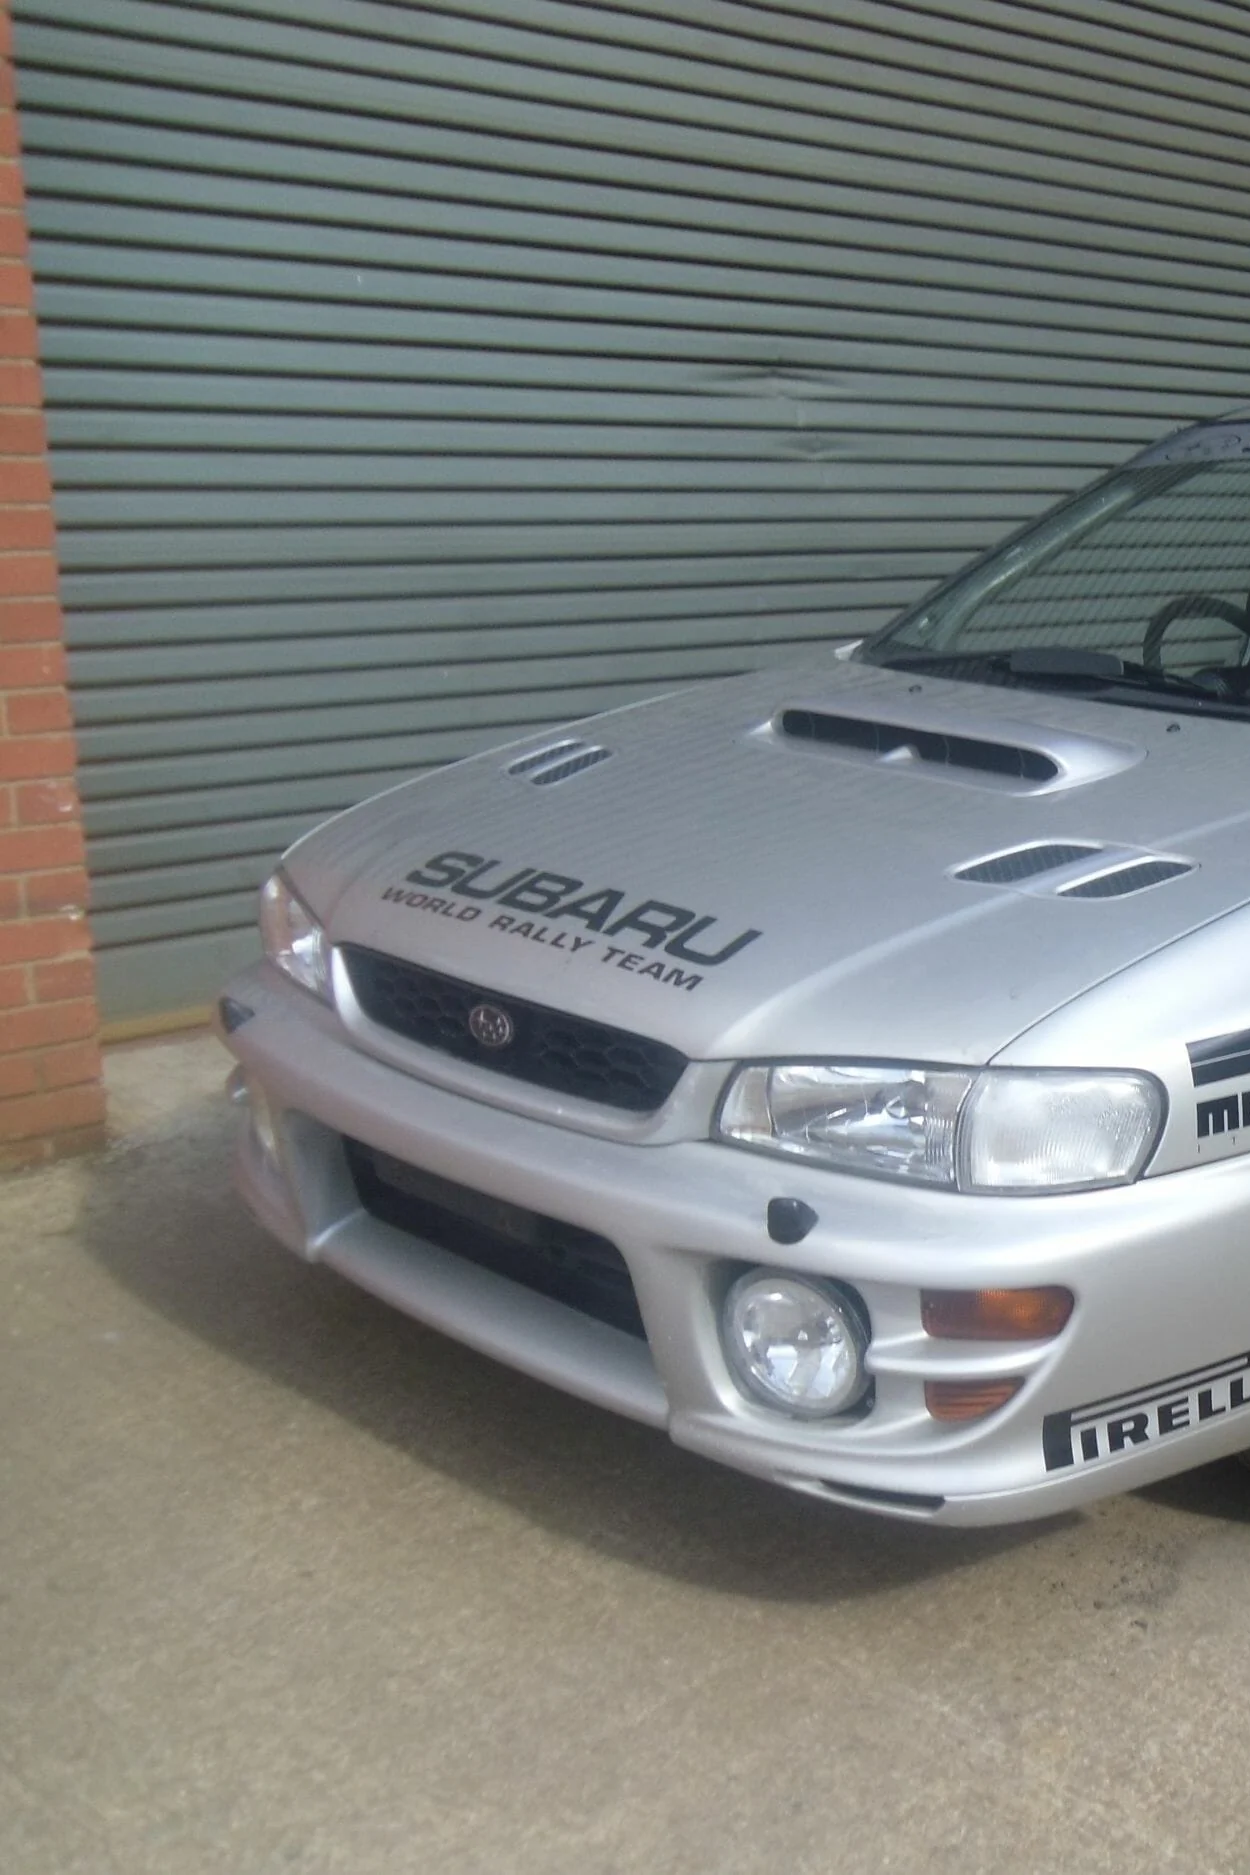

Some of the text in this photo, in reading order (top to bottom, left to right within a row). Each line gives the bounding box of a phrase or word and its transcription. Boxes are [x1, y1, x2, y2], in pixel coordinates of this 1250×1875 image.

[381, 887, 704, 992] WORLD RALLY TEAM
[405, 850, 763, 966] SUBARU
